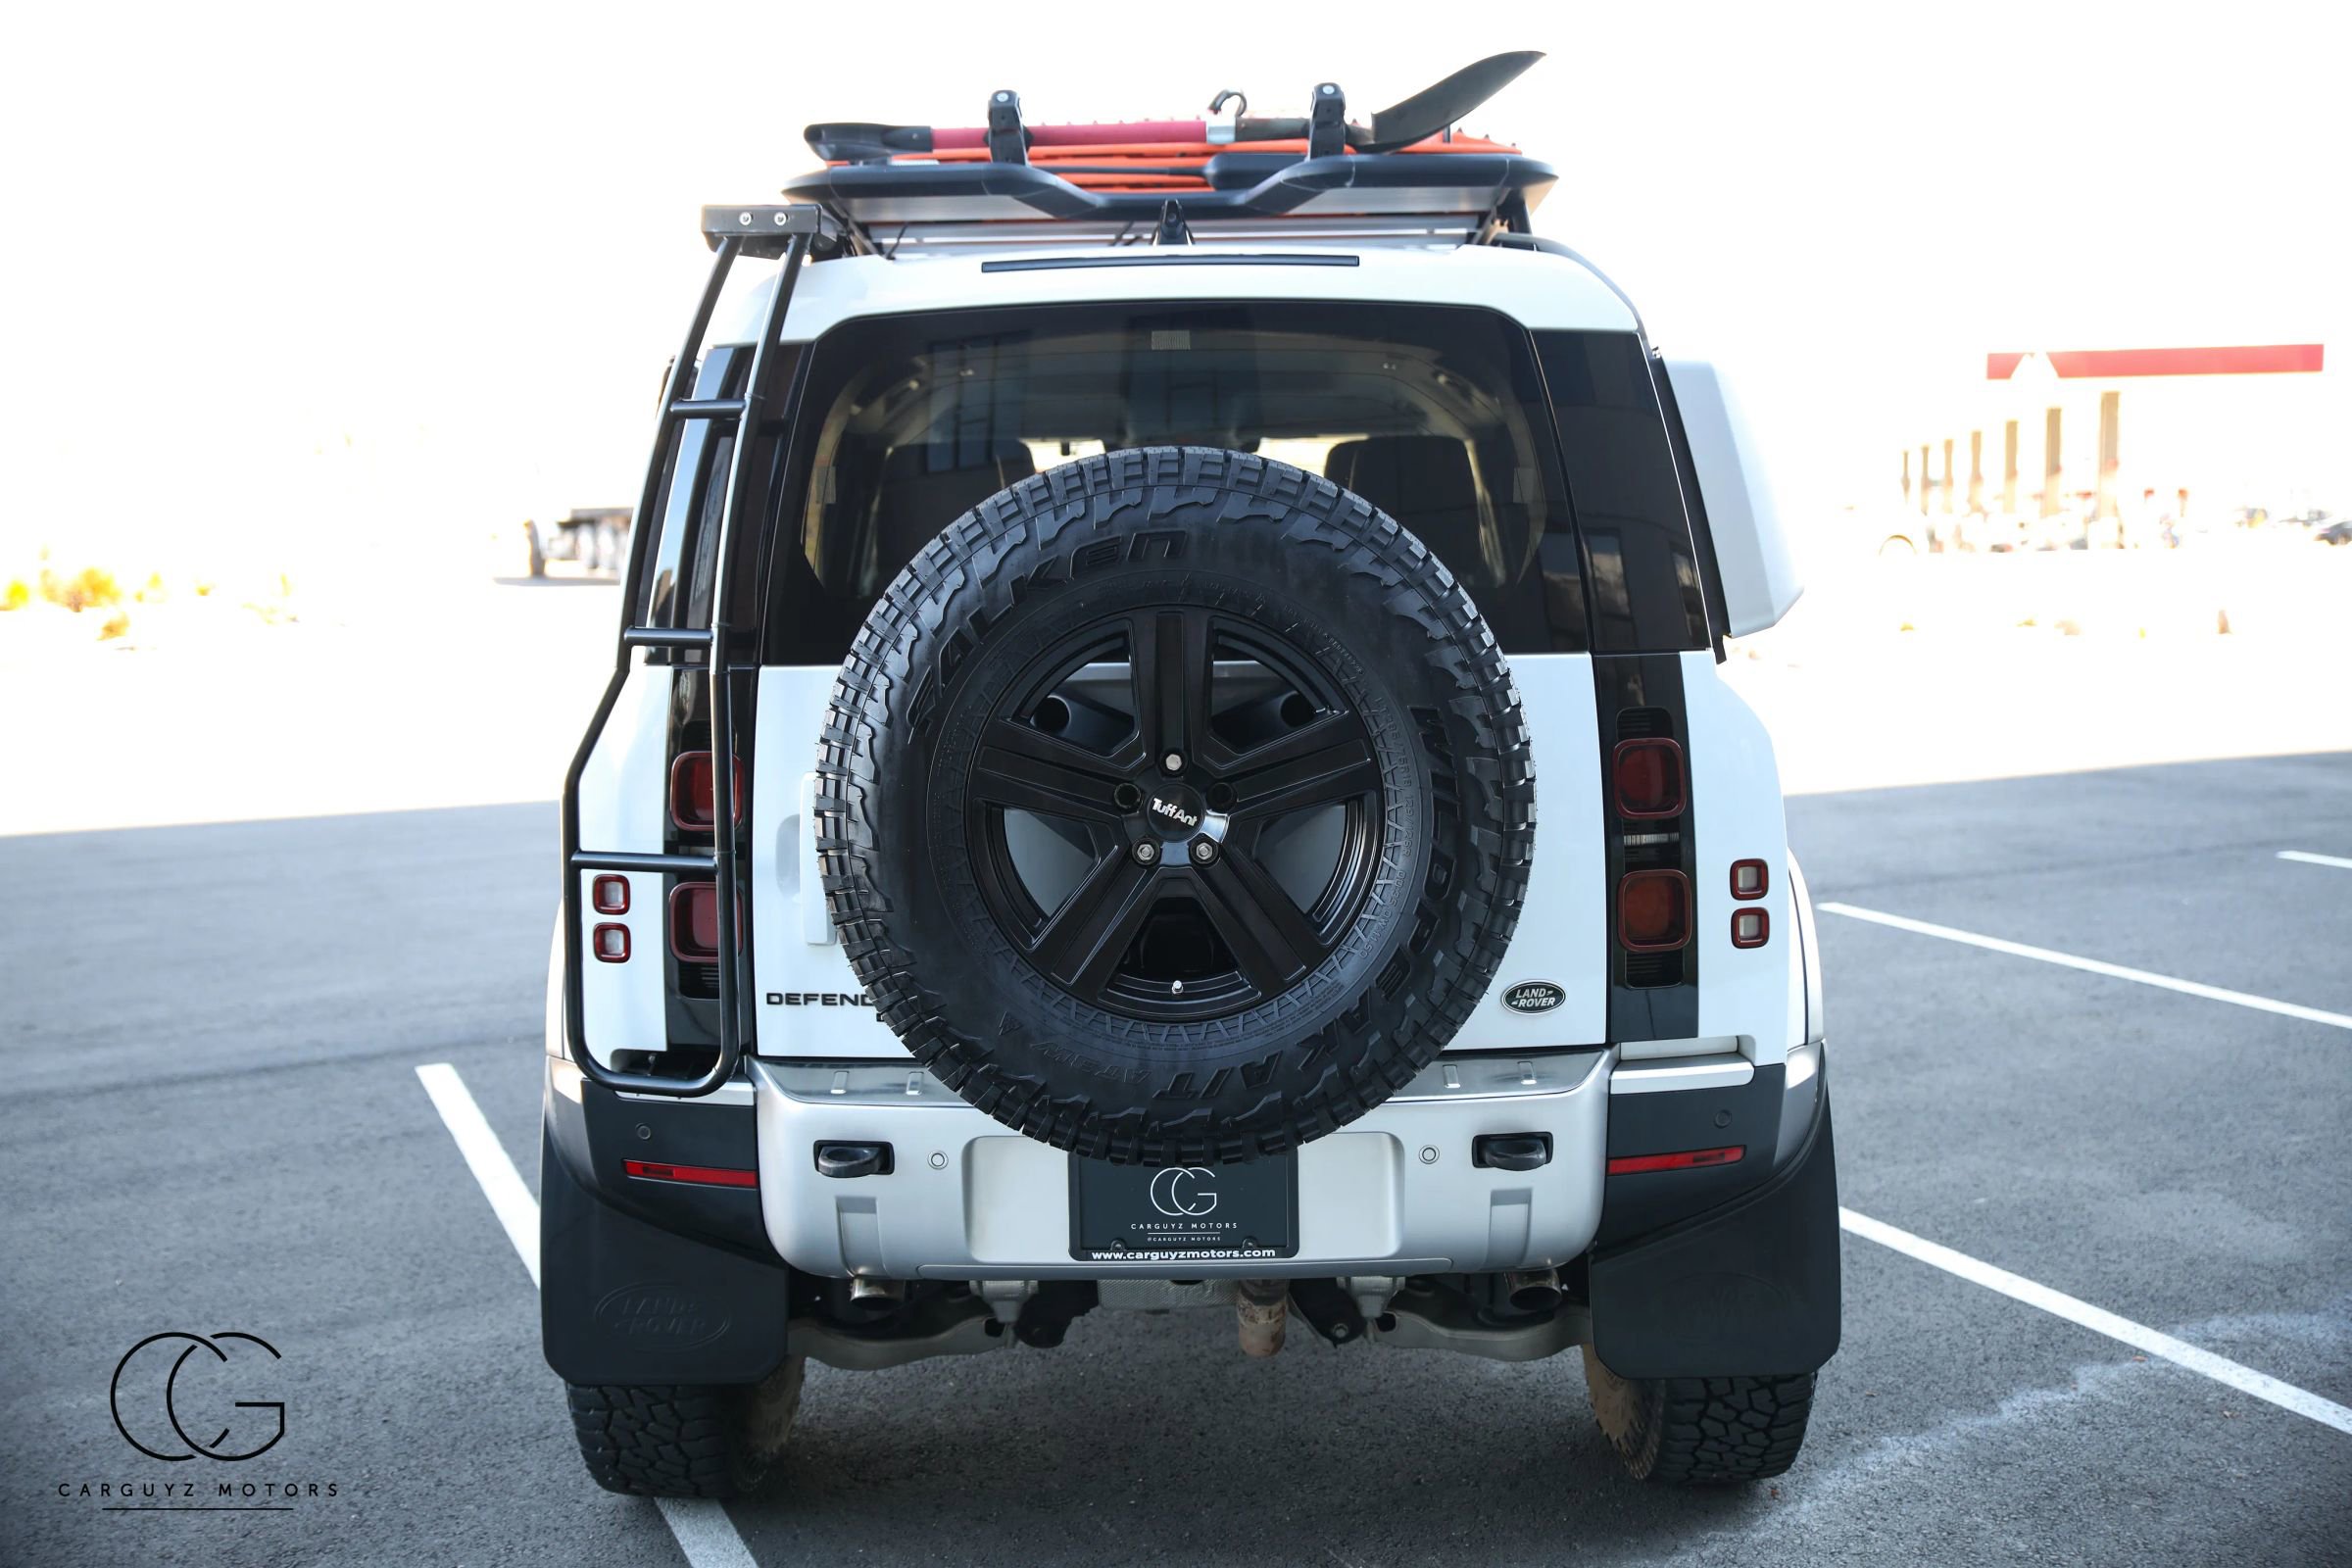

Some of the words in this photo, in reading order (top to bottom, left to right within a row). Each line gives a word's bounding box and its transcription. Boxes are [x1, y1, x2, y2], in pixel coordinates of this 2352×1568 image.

[906, 529, 1187, 744] FALKEN
[1298, 705, 1461, 1072] WILDPEAK
[1515, 988, 1546, 999] LAND
[1517, 997, 1556, 1007] ROVER
[1091, 1248, 1276, 1260] www.carguyzmotors.com
